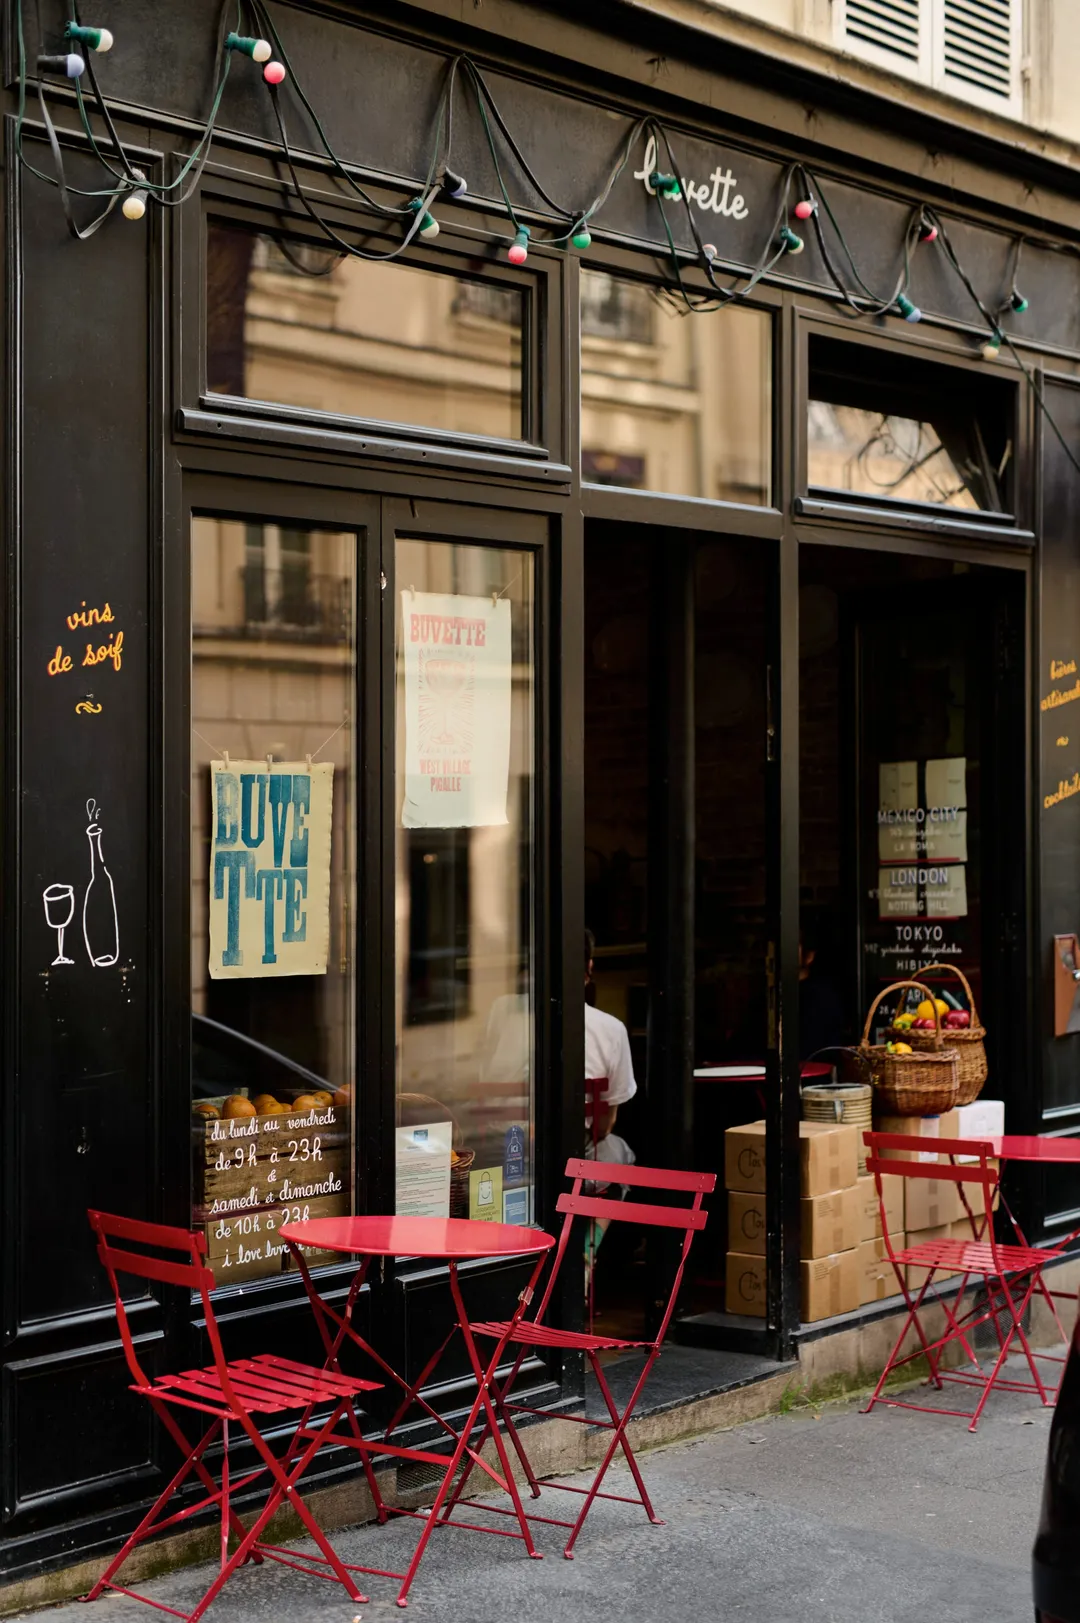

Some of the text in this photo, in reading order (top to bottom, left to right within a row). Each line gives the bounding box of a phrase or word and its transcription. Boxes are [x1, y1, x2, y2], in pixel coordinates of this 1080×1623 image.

[634, 135, 749, 220] bvette
[67, 601, 115, 631] vins
[410, 614, 486, 646] BUVETTE
[48, 631, 123, 676] de soif
[419, 759, 471, 775] WEST VILLAGE
[430, 776, 462, 792] PIGALLE
[215, 773, 310, 867] BUVE
[877, 807, 959, 825] MEXICO CITY
[890, 868, 948, 886] LONDON
[887, 899, 949, 912] NOTTING HILL
[896, 925, 943, 941] TOKYO
[211, 1107, 336, 1141] du lundi au vendredi
[215, 1152, 231, 1171] de
[270, 1147, 281, 1163] à
[288, 1137, 323, 1162] 23h
[209, 1172, 342, 1214] samedi et dimanche
[215, 1219, 232, 1240] de
[234, 1215, 261, 1235] 10h
[266, 1214, 276, 1230] à
[222, 1250, 232, 1268] i
[236, 1244, 262, 1264] love
